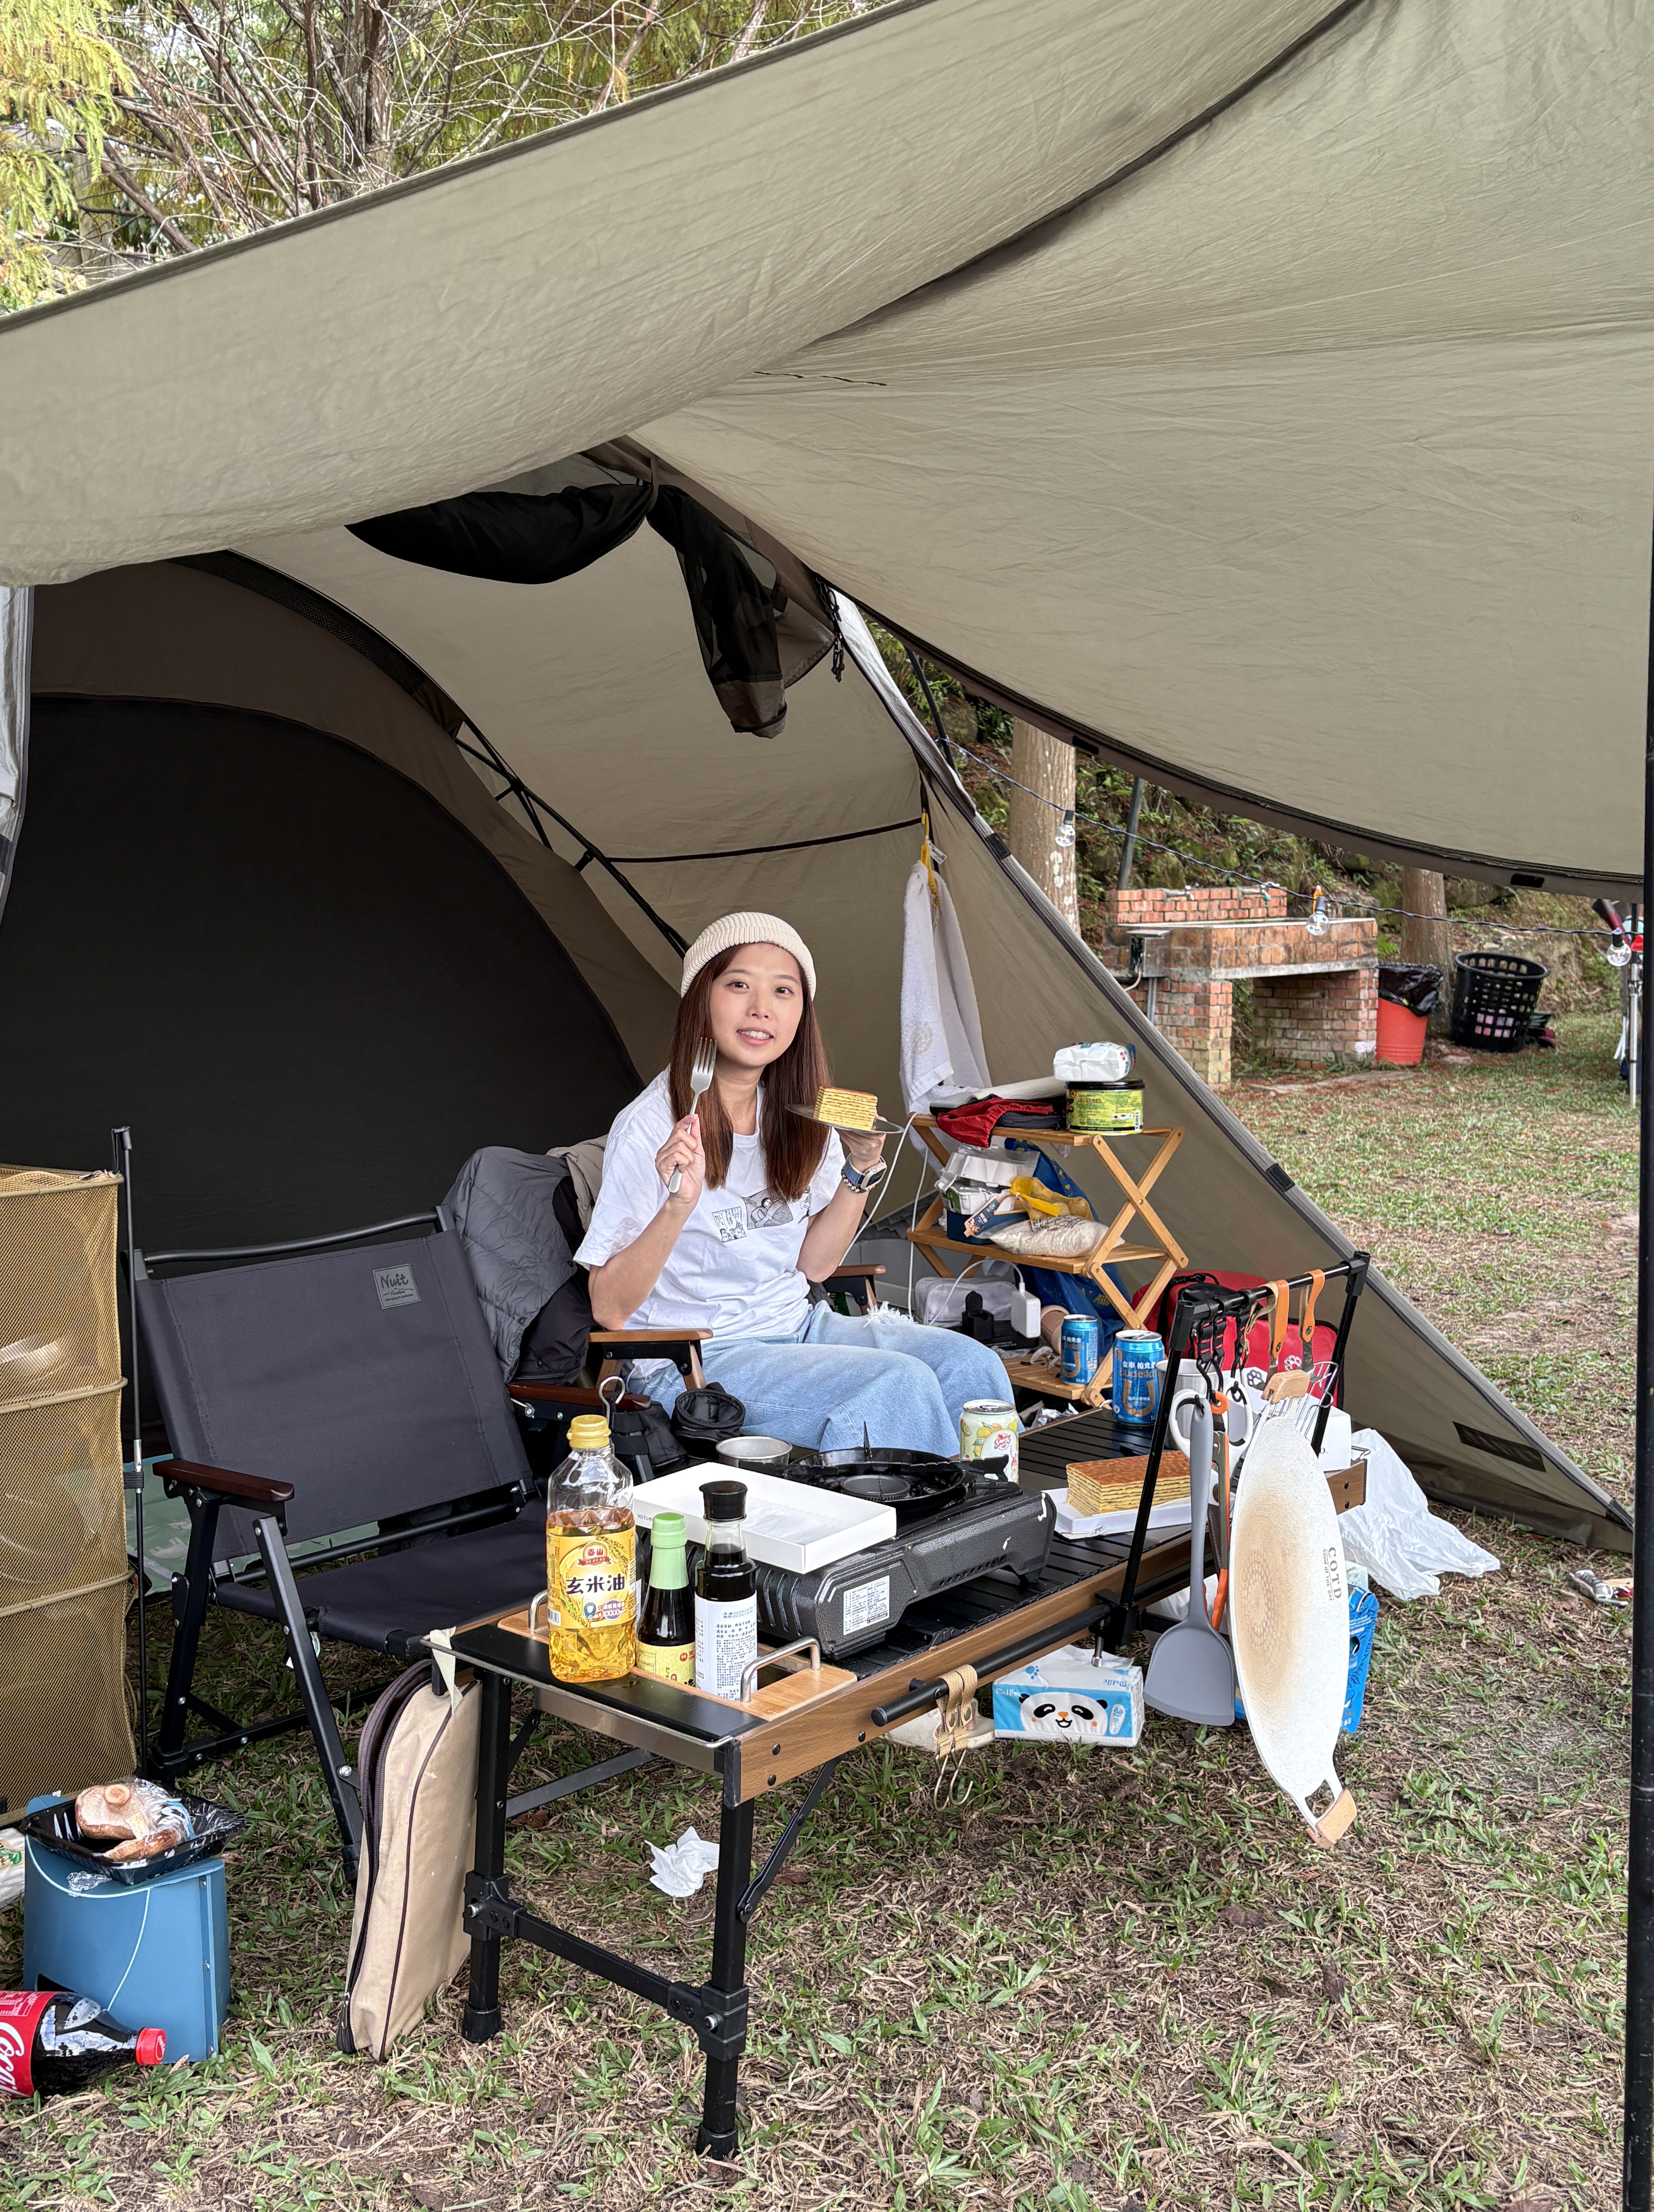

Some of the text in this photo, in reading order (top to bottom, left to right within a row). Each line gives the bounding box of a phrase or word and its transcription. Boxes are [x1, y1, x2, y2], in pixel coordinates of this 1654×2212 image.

[587, 1548, 603, 1556] 泰山
[566, 1573, 625, 1594] 玄米油
[1328, 1547, 1342, 1599] COTD
